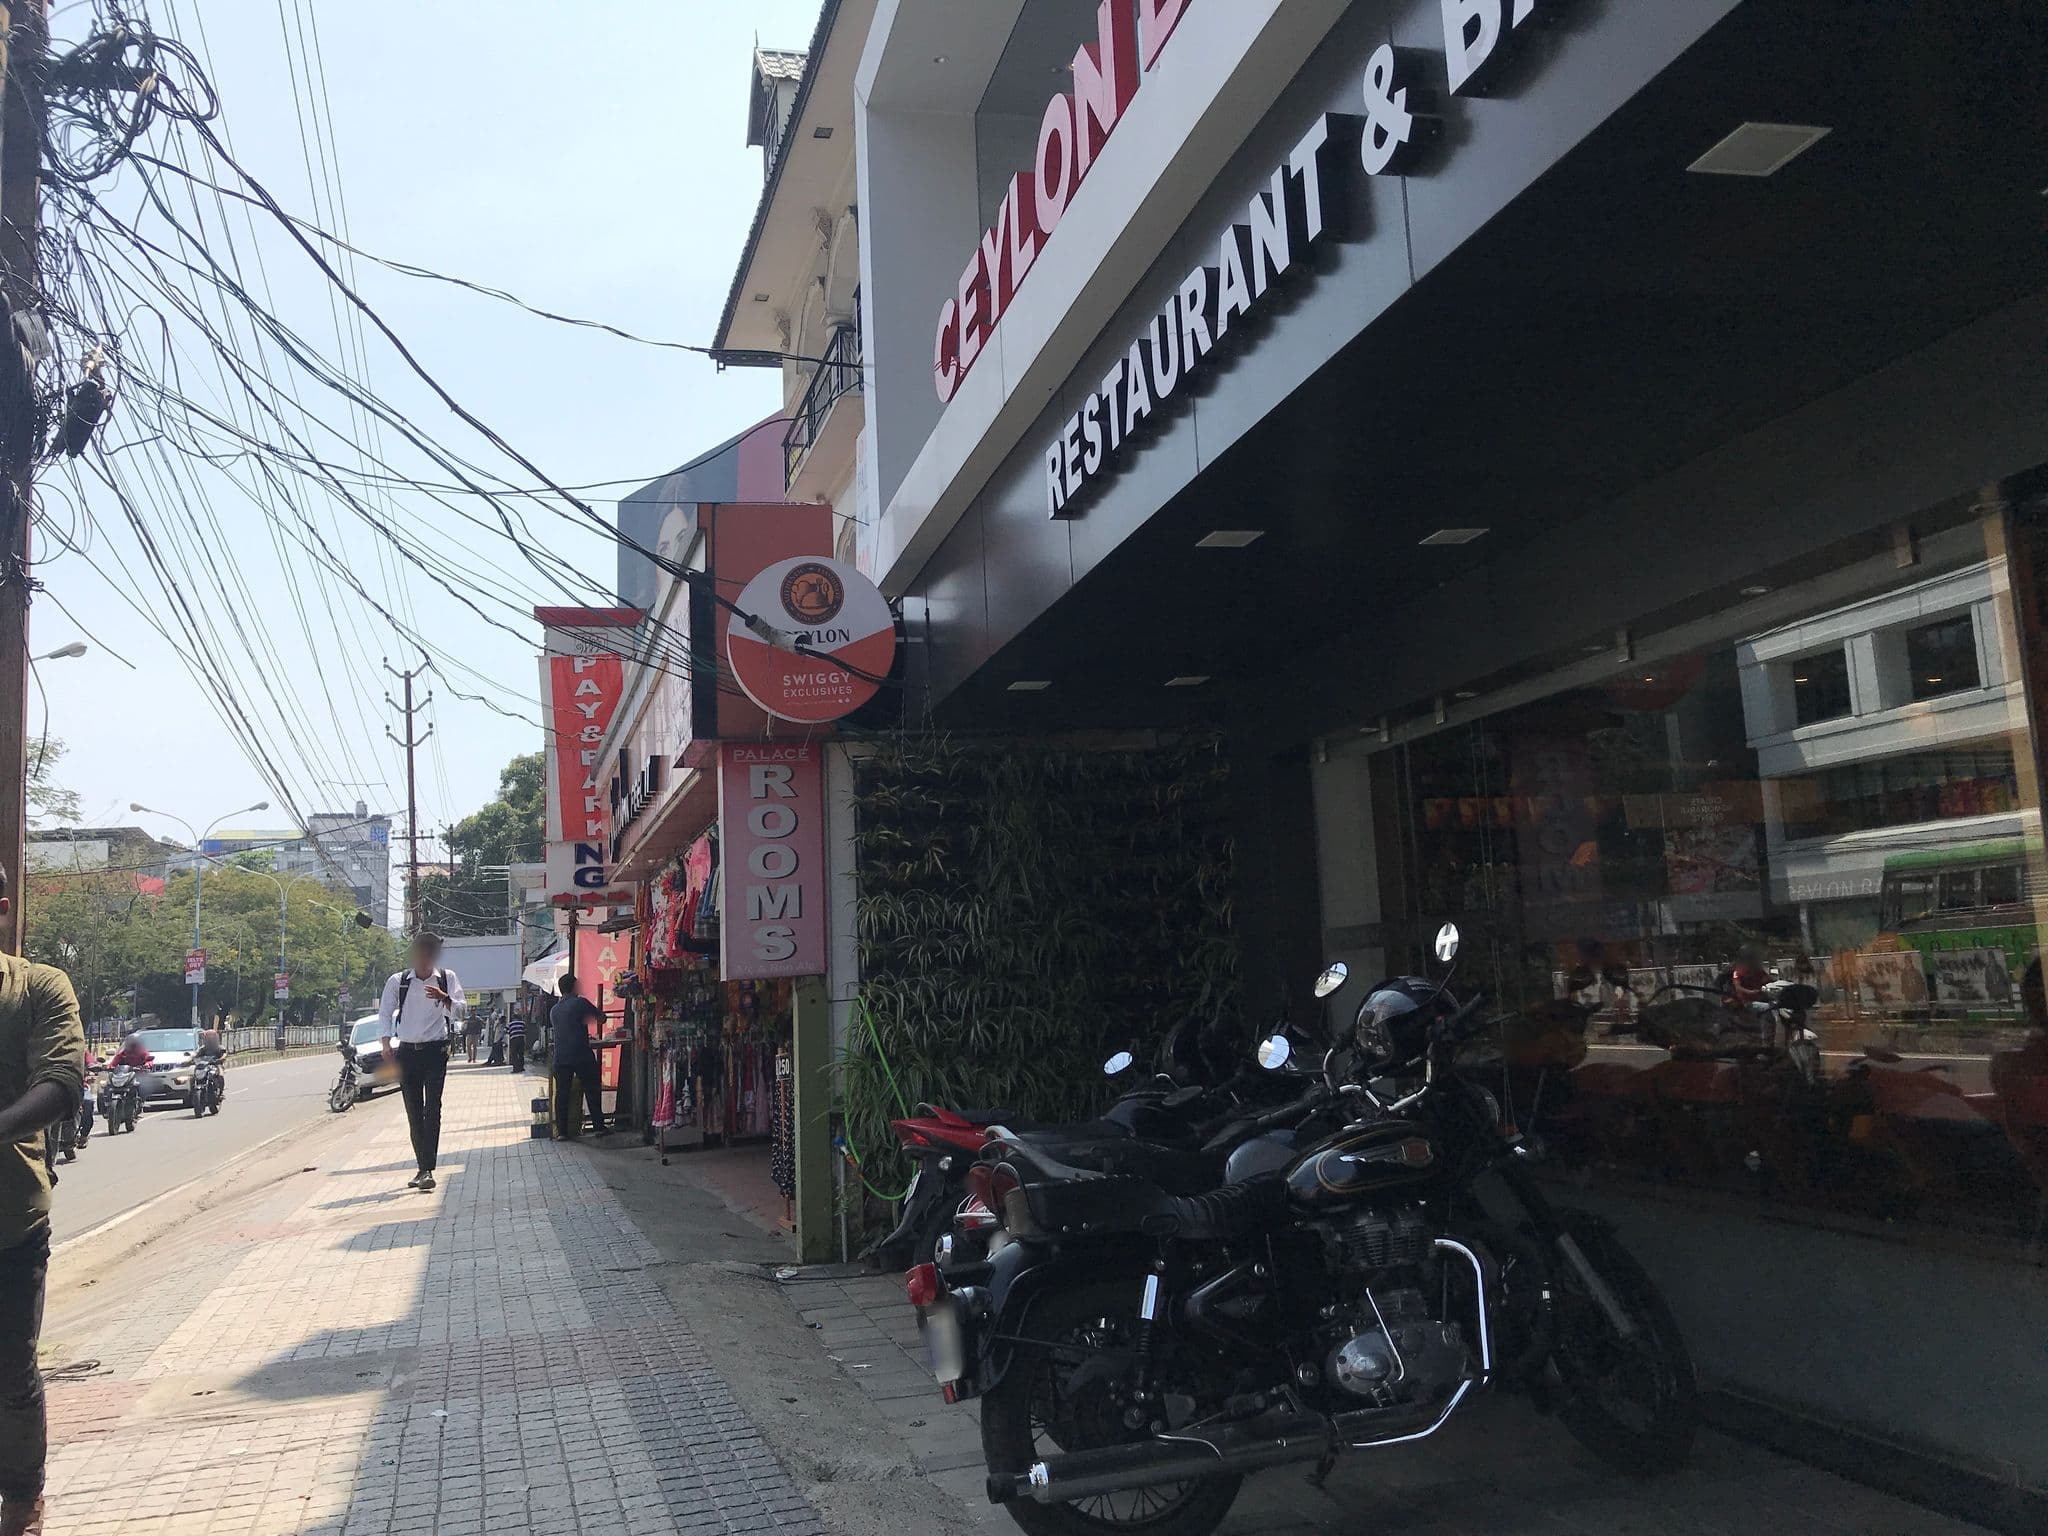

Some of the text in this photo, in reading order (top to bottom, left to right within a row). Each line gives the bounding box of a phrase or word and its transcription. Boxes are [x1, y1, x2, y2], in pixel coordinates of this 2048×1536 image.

[934, 0, 1120, 403] CEYLON
[1045, 112, 1328, 521] RESTAURANT
[1361, 43, 1413, 176] &
[783, 672, 850, 686] SWIGGY
[783, 686, 853, 698] EXCLUSIVES
[733, 748, 809, 761] PALACE
[747, 764, 802, 962] ROOMS
